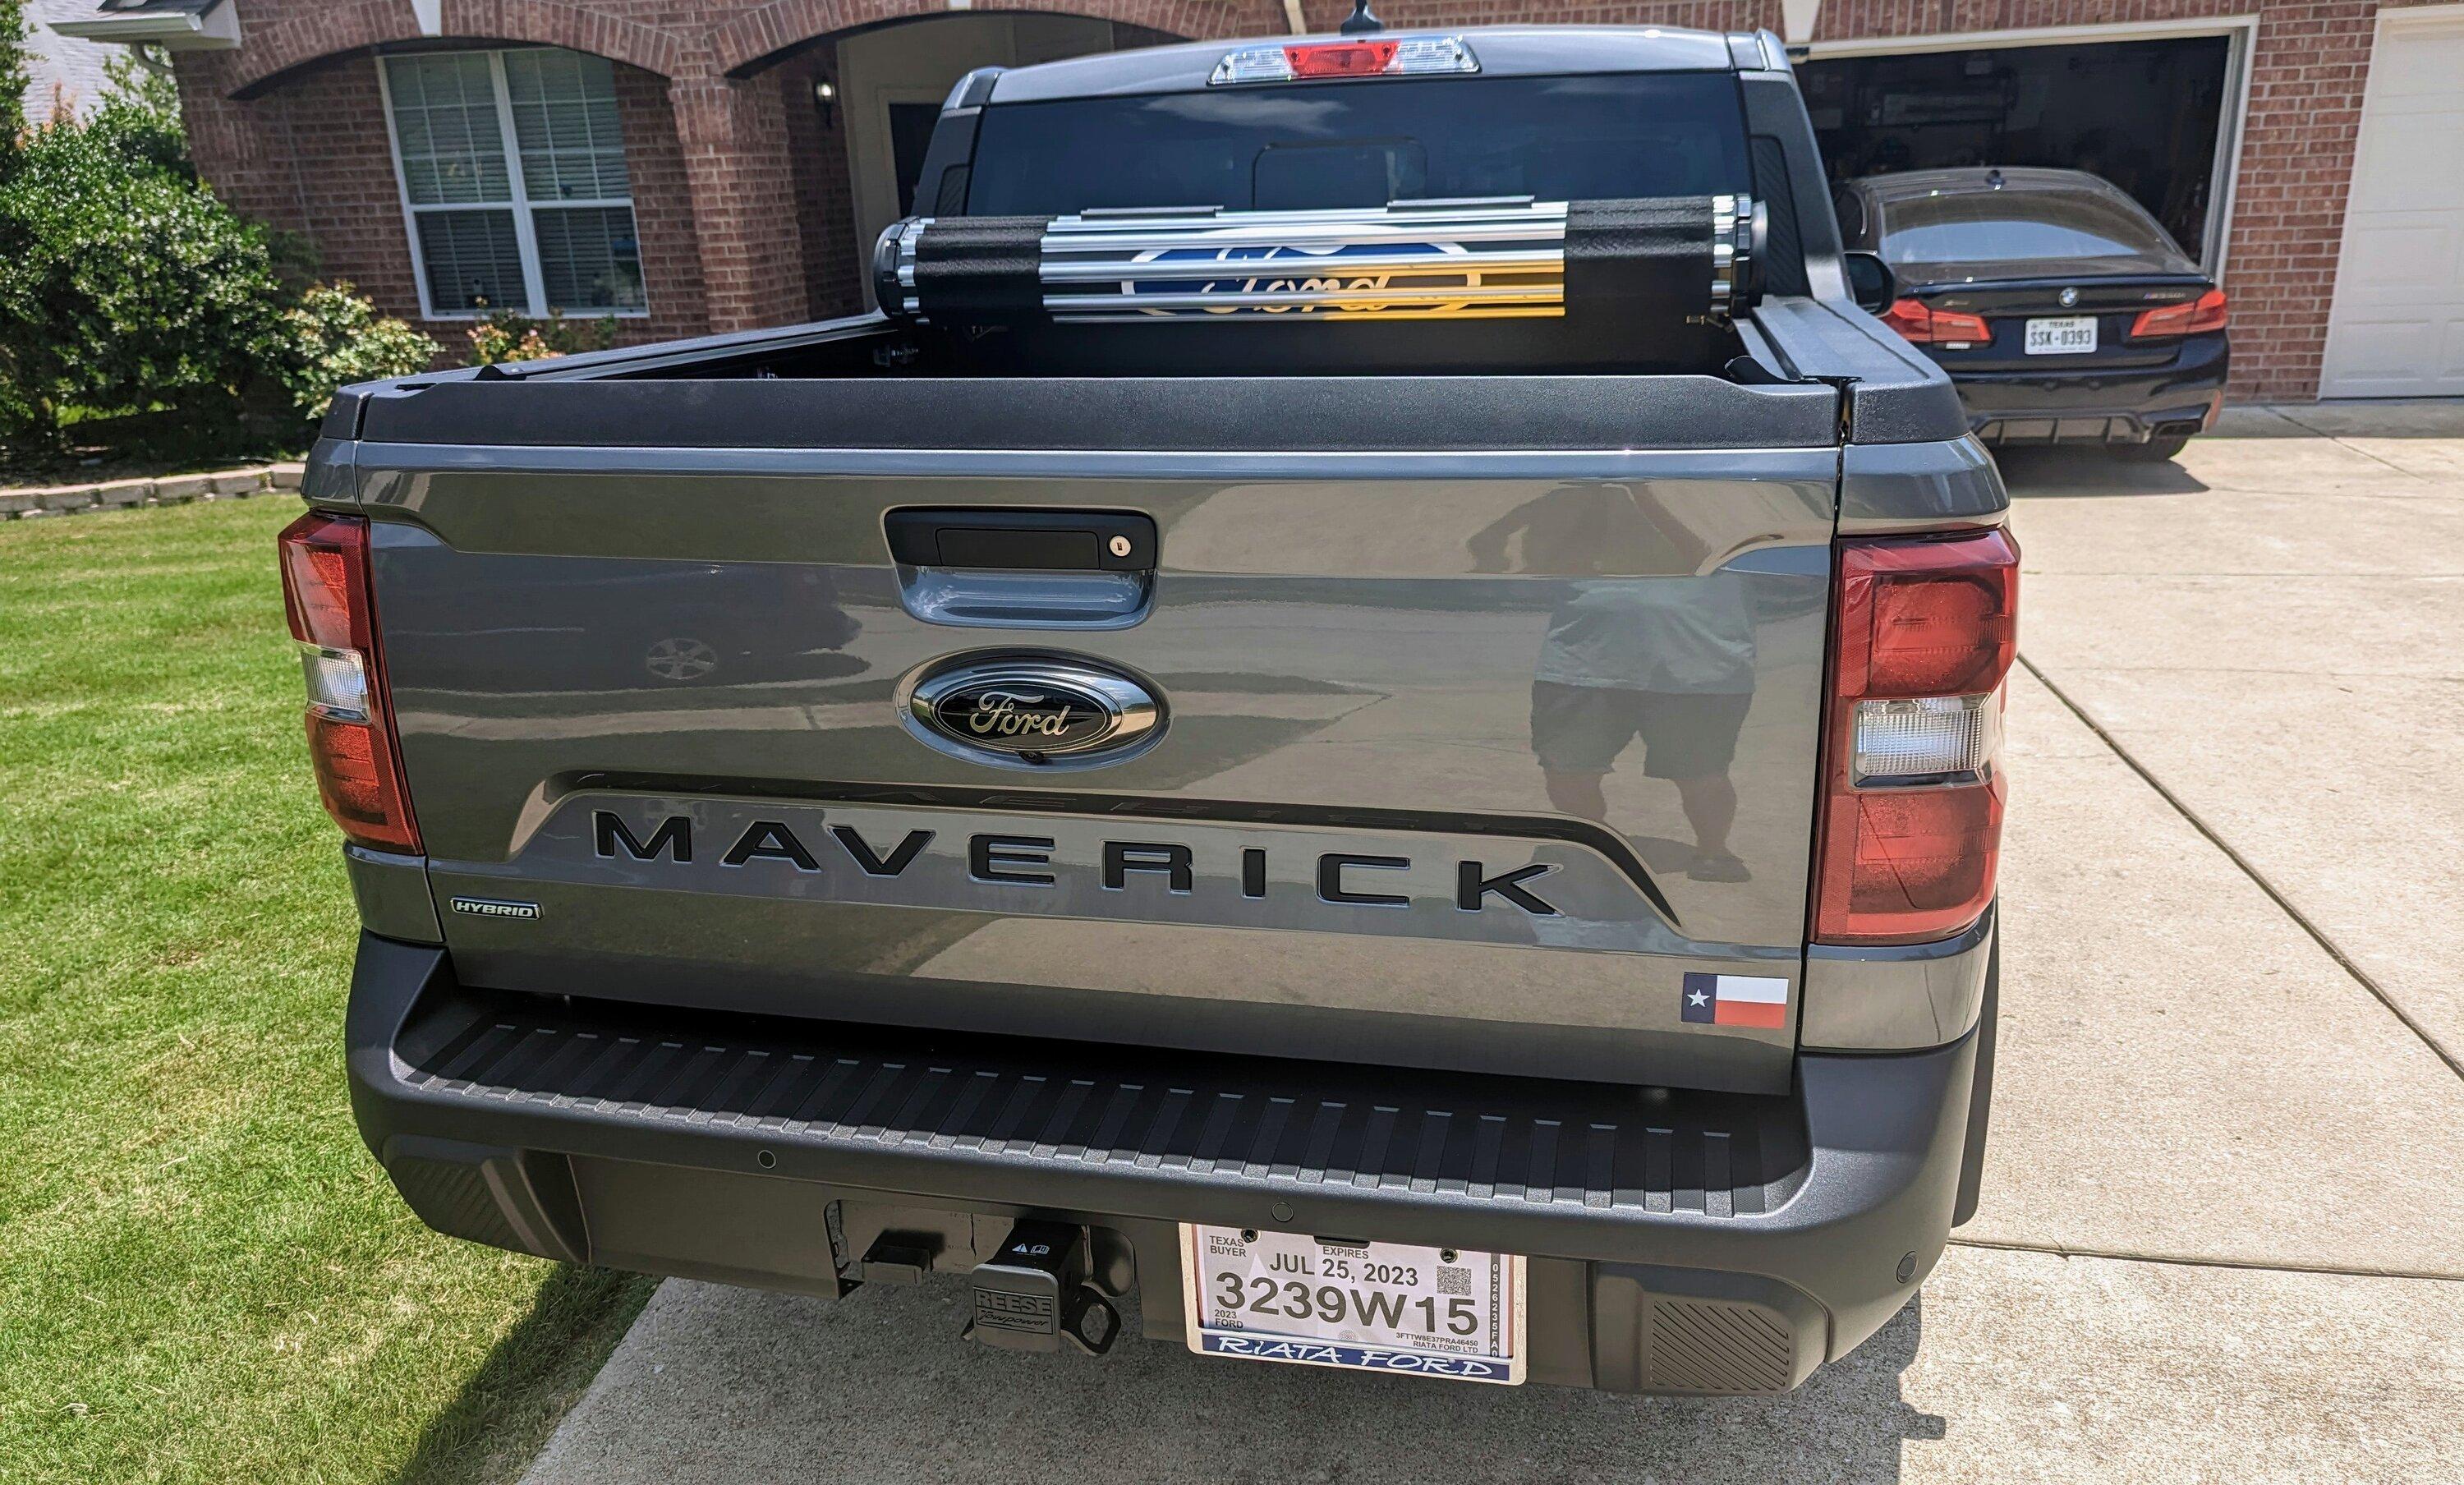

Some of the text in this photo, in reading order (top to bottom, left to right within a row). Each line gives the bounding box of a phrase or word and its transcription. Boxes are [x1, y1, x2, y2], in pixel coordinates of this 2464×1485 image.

[969, 691, 1071, 736] Ford
[593, 810, 1564, 917] MAVERICK
[456, 901, 534, 917] HYBRID
[1210, 1235, 1244, 1248] TEXAS
[1211, 1246, 1247, 1257] BUYER
[1322, 1246, 1369, 1259] EXPIRES
[1270, 1253, 1418, 1287] JUL 25, 2023
[976, 1290, 1053, 1316] REESE
[1216, 1271, 1478, 1336] 3239W15
[1214, 1308, 1238, 1320] 2023
[1215, 1317, 1244, 1330] FORD
[1413, 1340, 1437, 1350] RIATA
[1439, 1344, 1462, 1353] FORD
[1217, 1336, 1493, 1377] RIATA FORD
